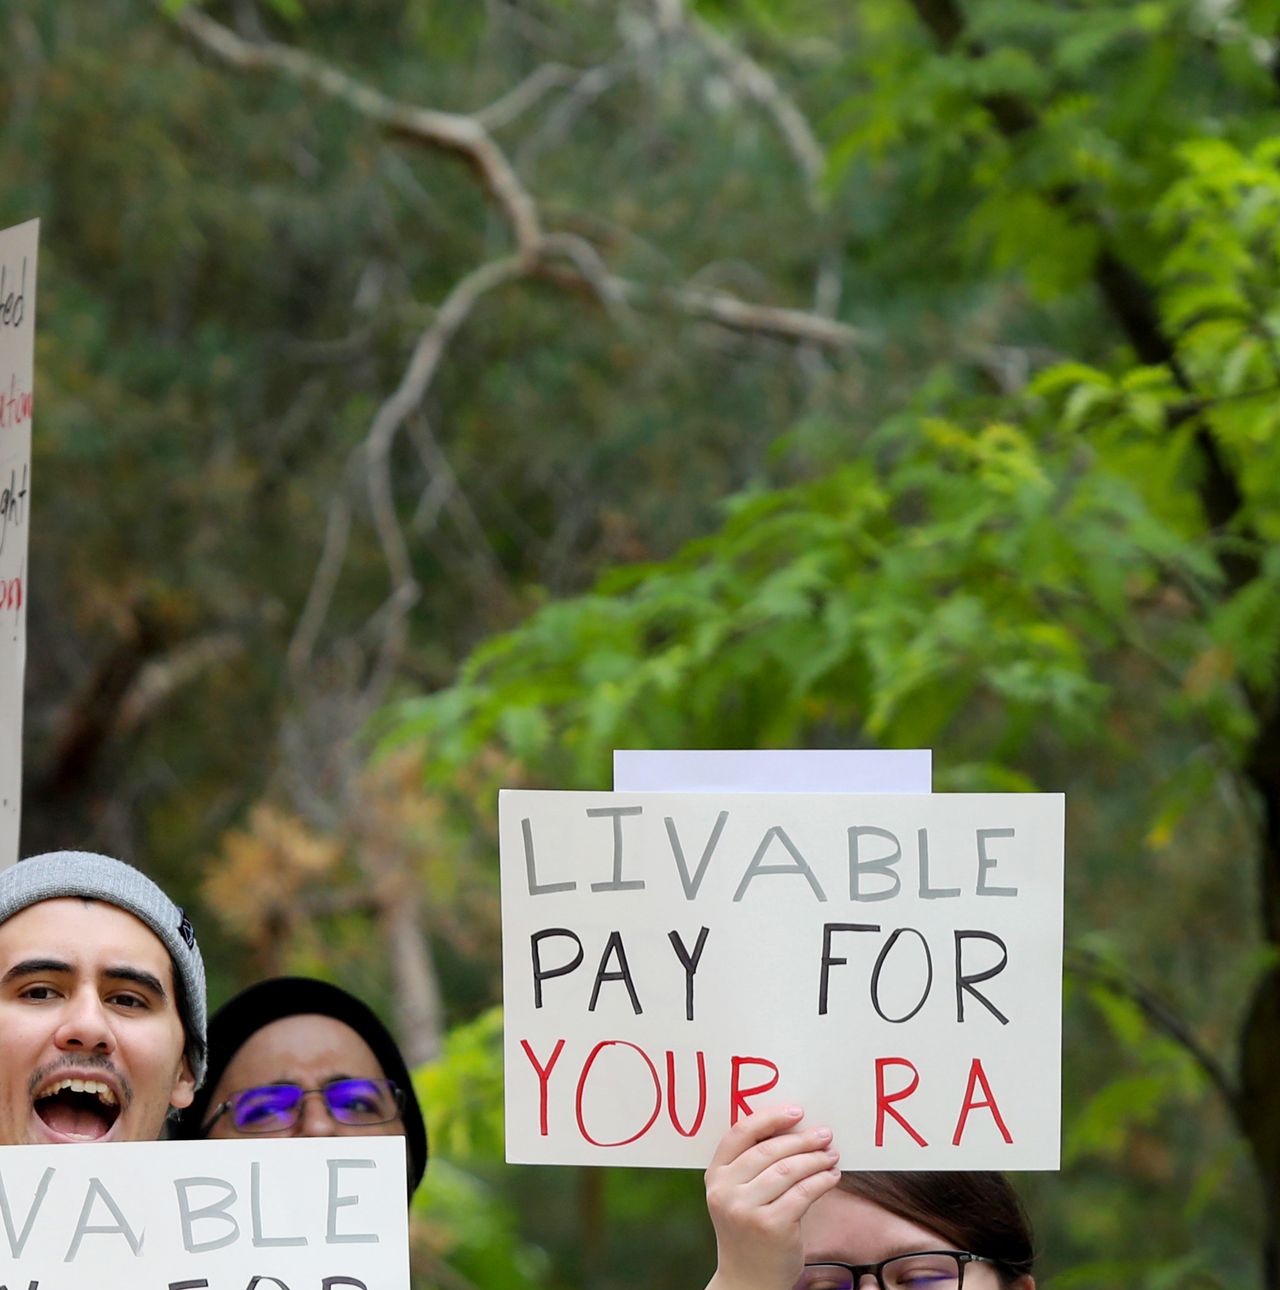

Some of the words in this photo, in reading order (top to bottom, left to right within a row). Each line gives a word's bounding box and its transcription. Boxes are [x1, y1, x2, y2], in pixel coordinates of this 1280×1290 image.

[521, 806, 1017, 902] LIVABLE
[531, 926, 710, 1021] PAY
[819, 923, 1010, 1024] FOR
[520, 1038, 780, 1147] YOUR
[875, 1057, 1013, 1147] RA
